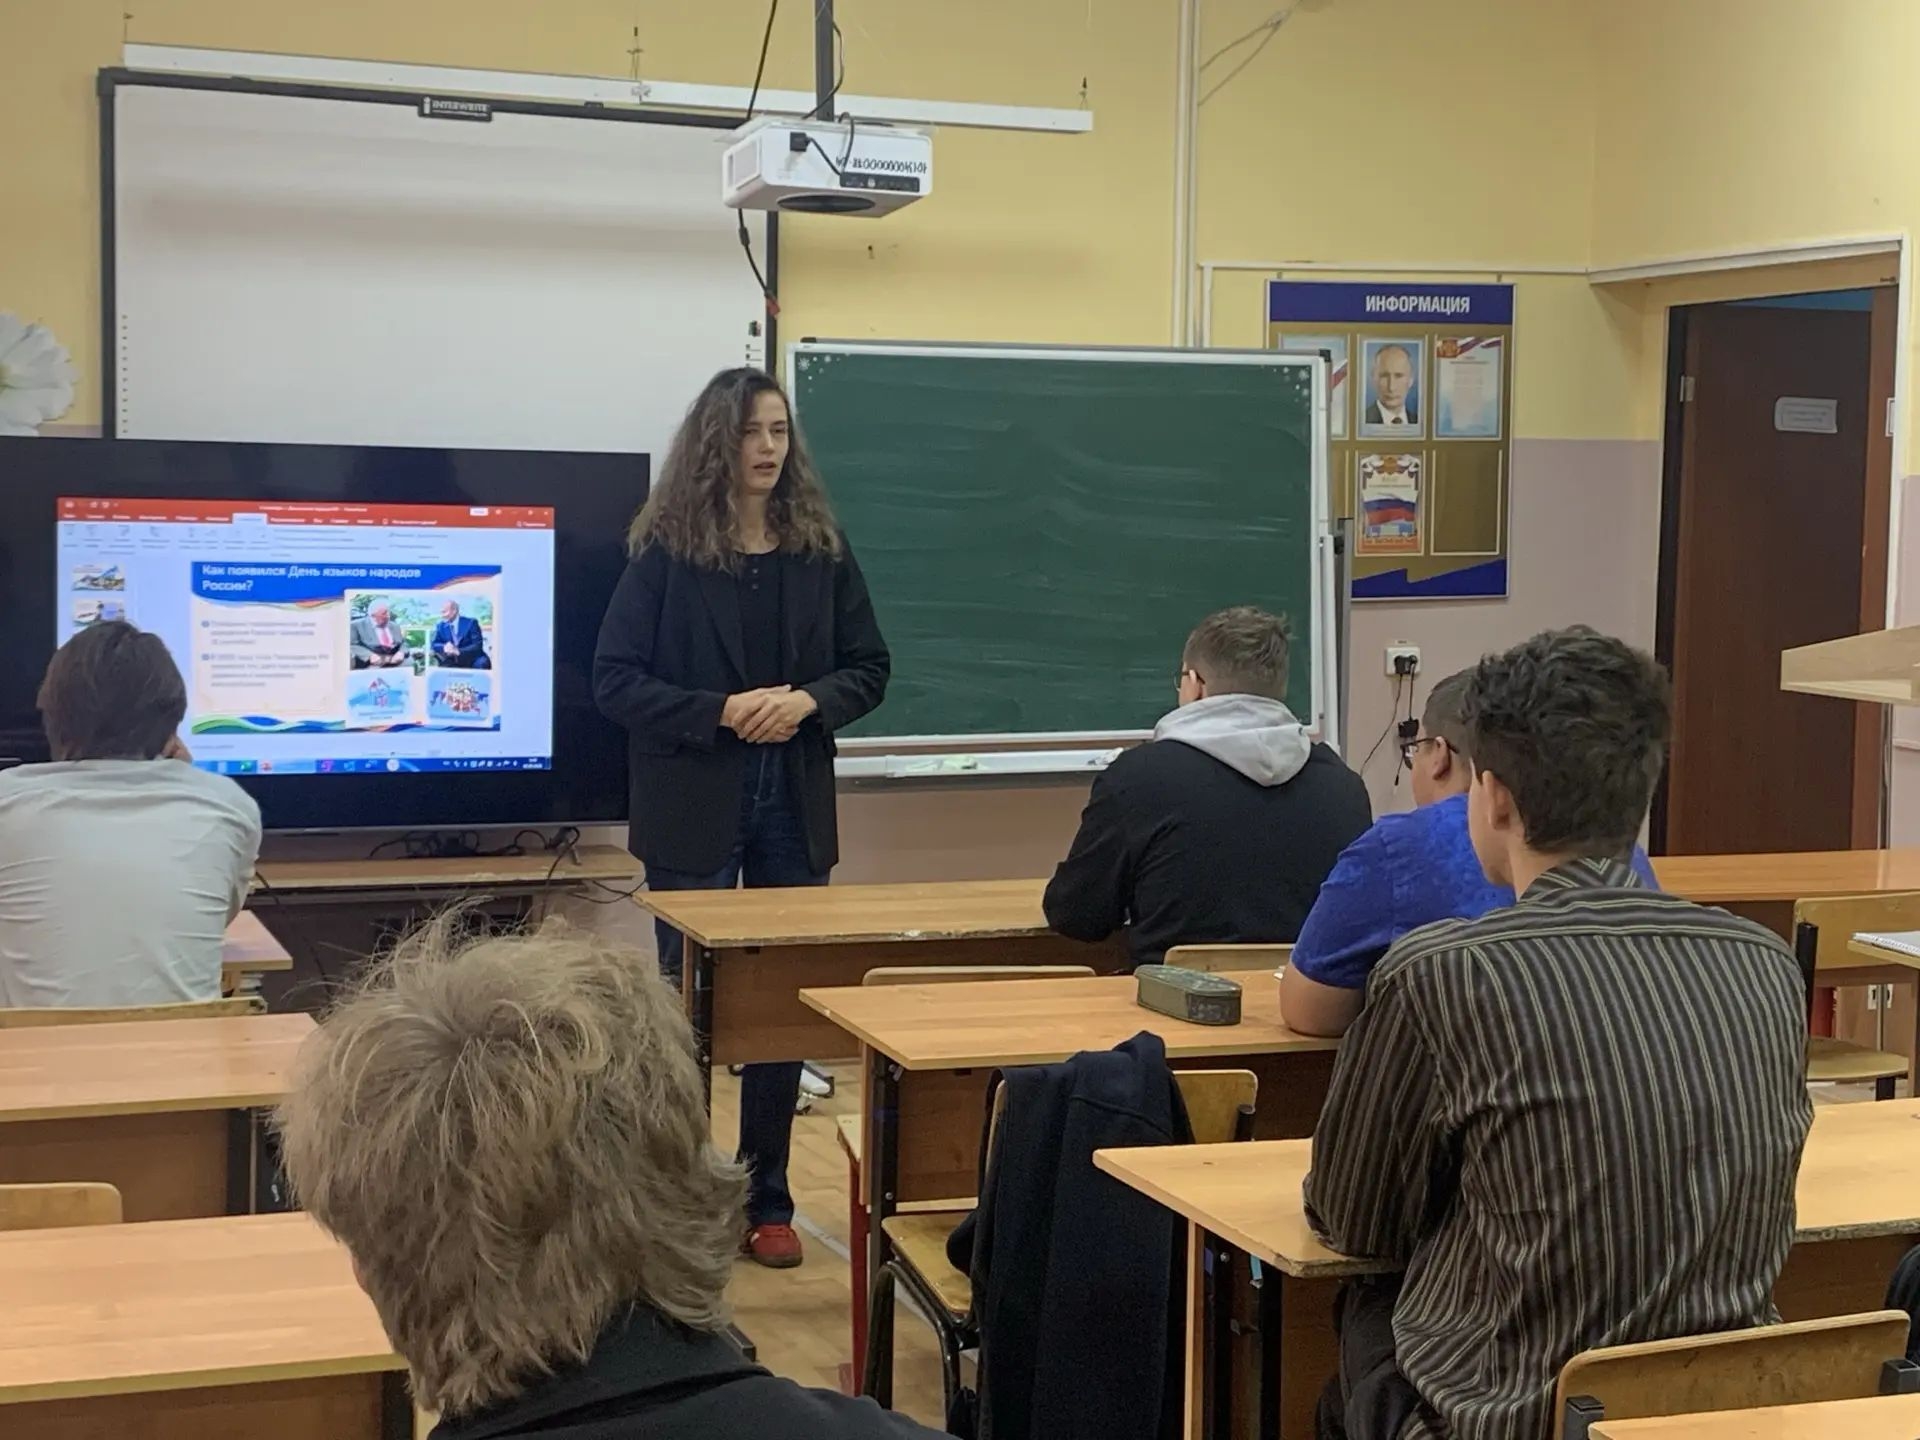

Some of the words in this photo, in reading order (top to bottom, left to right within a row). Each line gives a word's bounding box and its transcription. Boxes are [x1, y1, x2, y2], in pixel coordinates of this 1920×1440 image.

[1366, 296, 1470, 315] ИНФОРМАЦИЯ
[202, 565, 225, 576] Как
[228, 566, 286, 577] появился
[288, 565, 320, 579] День
[323, 567, 366, 578] языков
[369, 568, 421, 580] народов
[202, 579, 253, 591] России?
